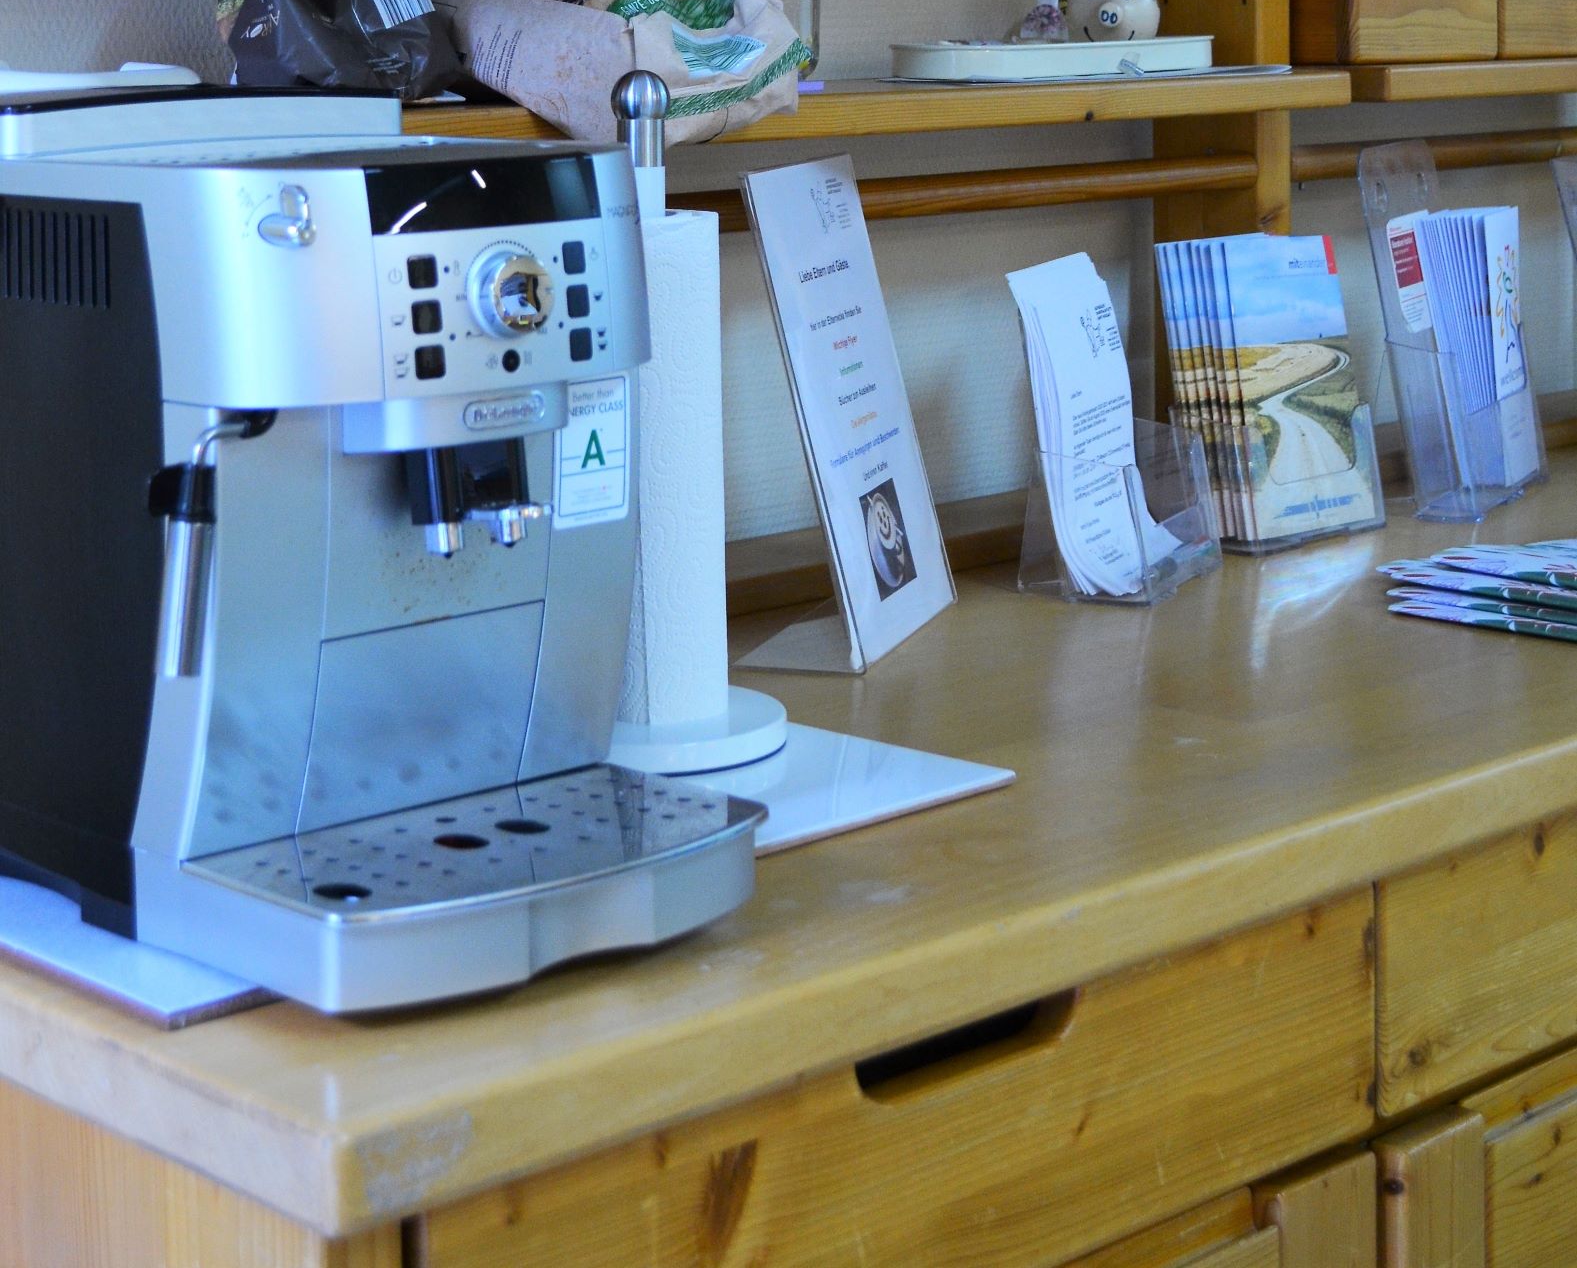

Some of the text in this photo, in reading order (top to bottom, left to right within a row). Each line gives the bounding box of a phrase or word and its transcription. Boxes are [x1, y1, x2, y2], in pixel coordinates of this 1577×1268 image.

[799, 270, 813, 283] Liebe
[812, 267, 827, 279] Eltern
[827, 262, 836, 274] und
[569, 400, 624, 417] NERGY CLASS
[581, 429, 606, 468] A
